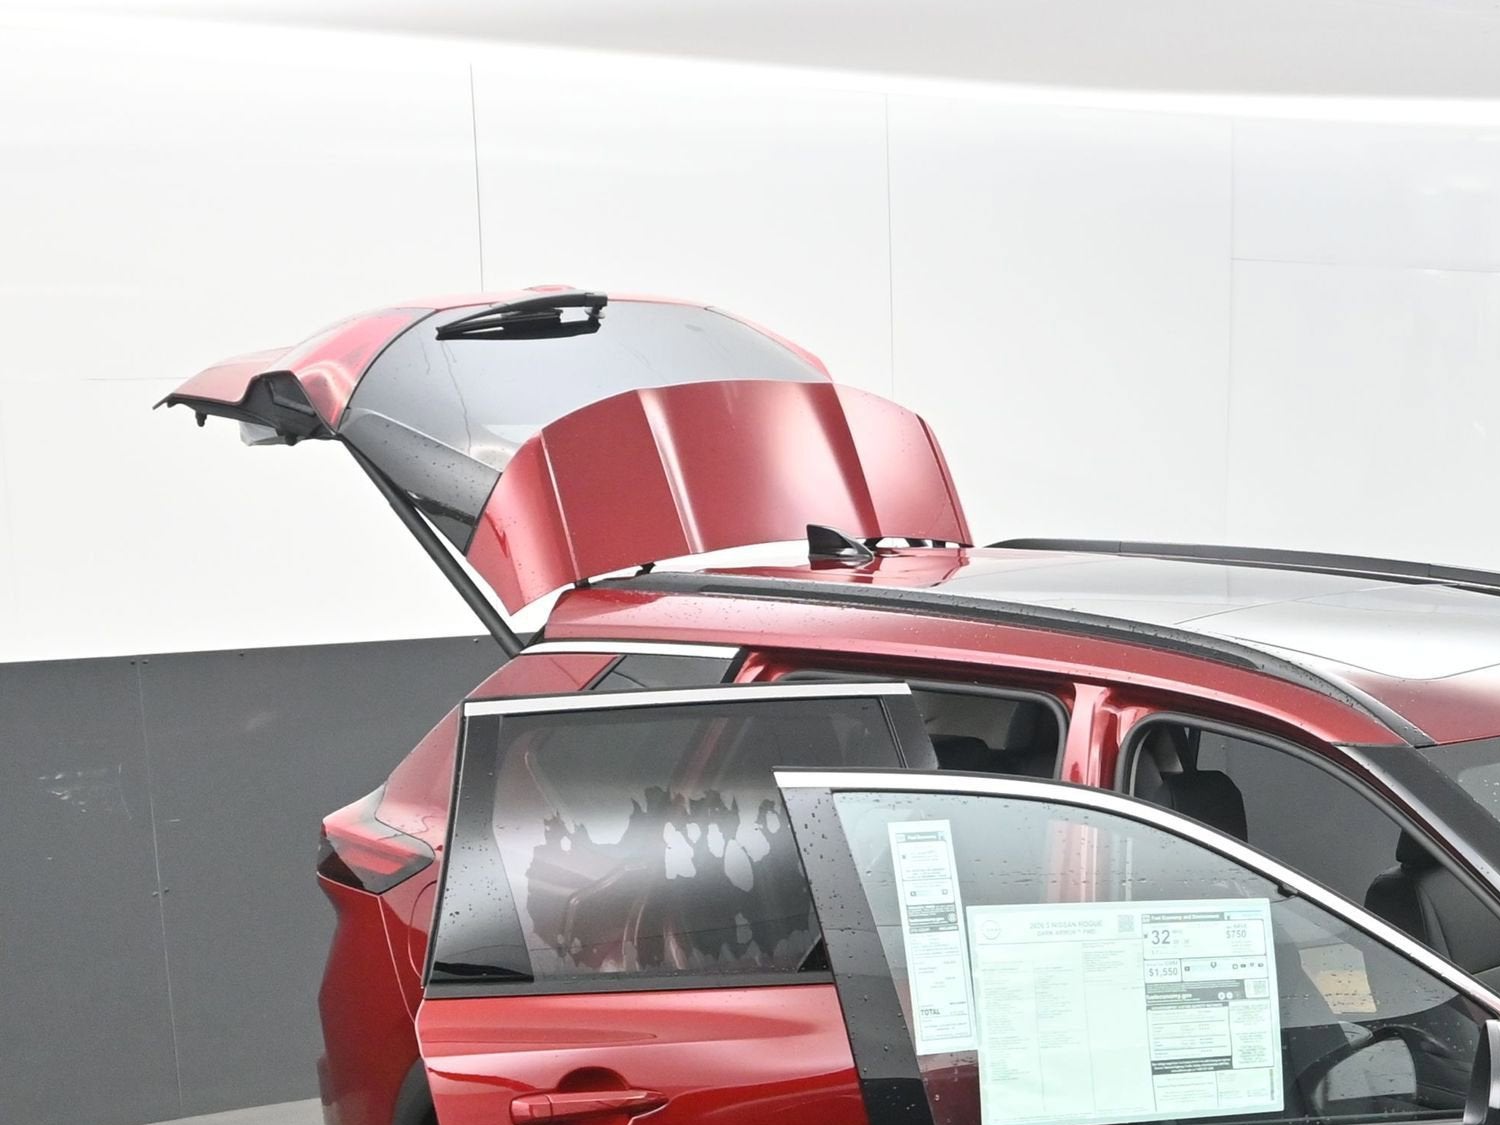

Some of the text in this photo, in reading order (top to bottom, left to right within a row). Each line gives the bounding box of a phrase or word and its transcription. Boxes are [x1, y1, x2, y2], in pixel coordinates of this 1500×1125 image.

[1151, 929, 1171, 945] 32
[1225, 929, 1247, 939] $750
[1148, 967, 1178, 978] $1,550
[920, 1008, 941, 1016] TOTAL
